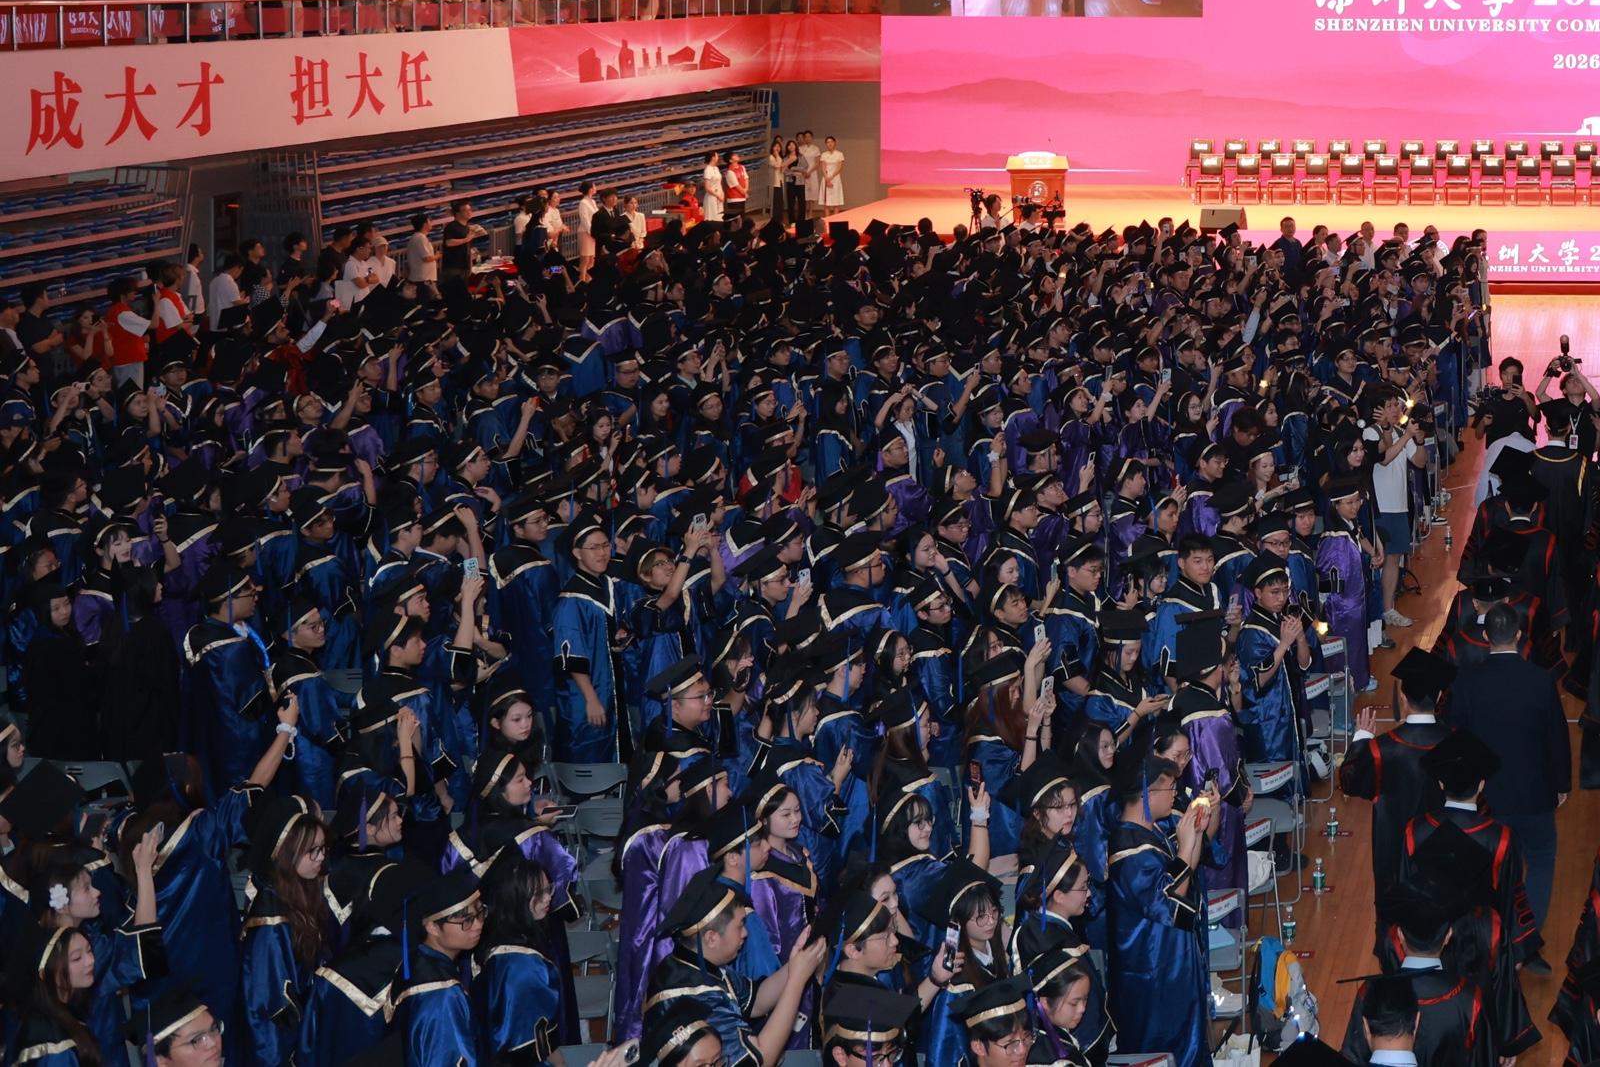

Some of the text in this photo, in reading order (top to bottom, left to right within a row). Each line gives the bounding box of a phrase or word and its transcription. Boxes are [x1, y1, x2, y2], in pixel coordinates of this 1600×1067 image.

[1314, 18, 1424, 33] SHENZHEN
[1429, 18, 1552, 33] UNIVERSITY
[26, 49, 434, 156] 成大才 担大任
[1486, 239, 1580, 266] 圳大学
[1530, 265, 1600, 273] UNIVERSITY
